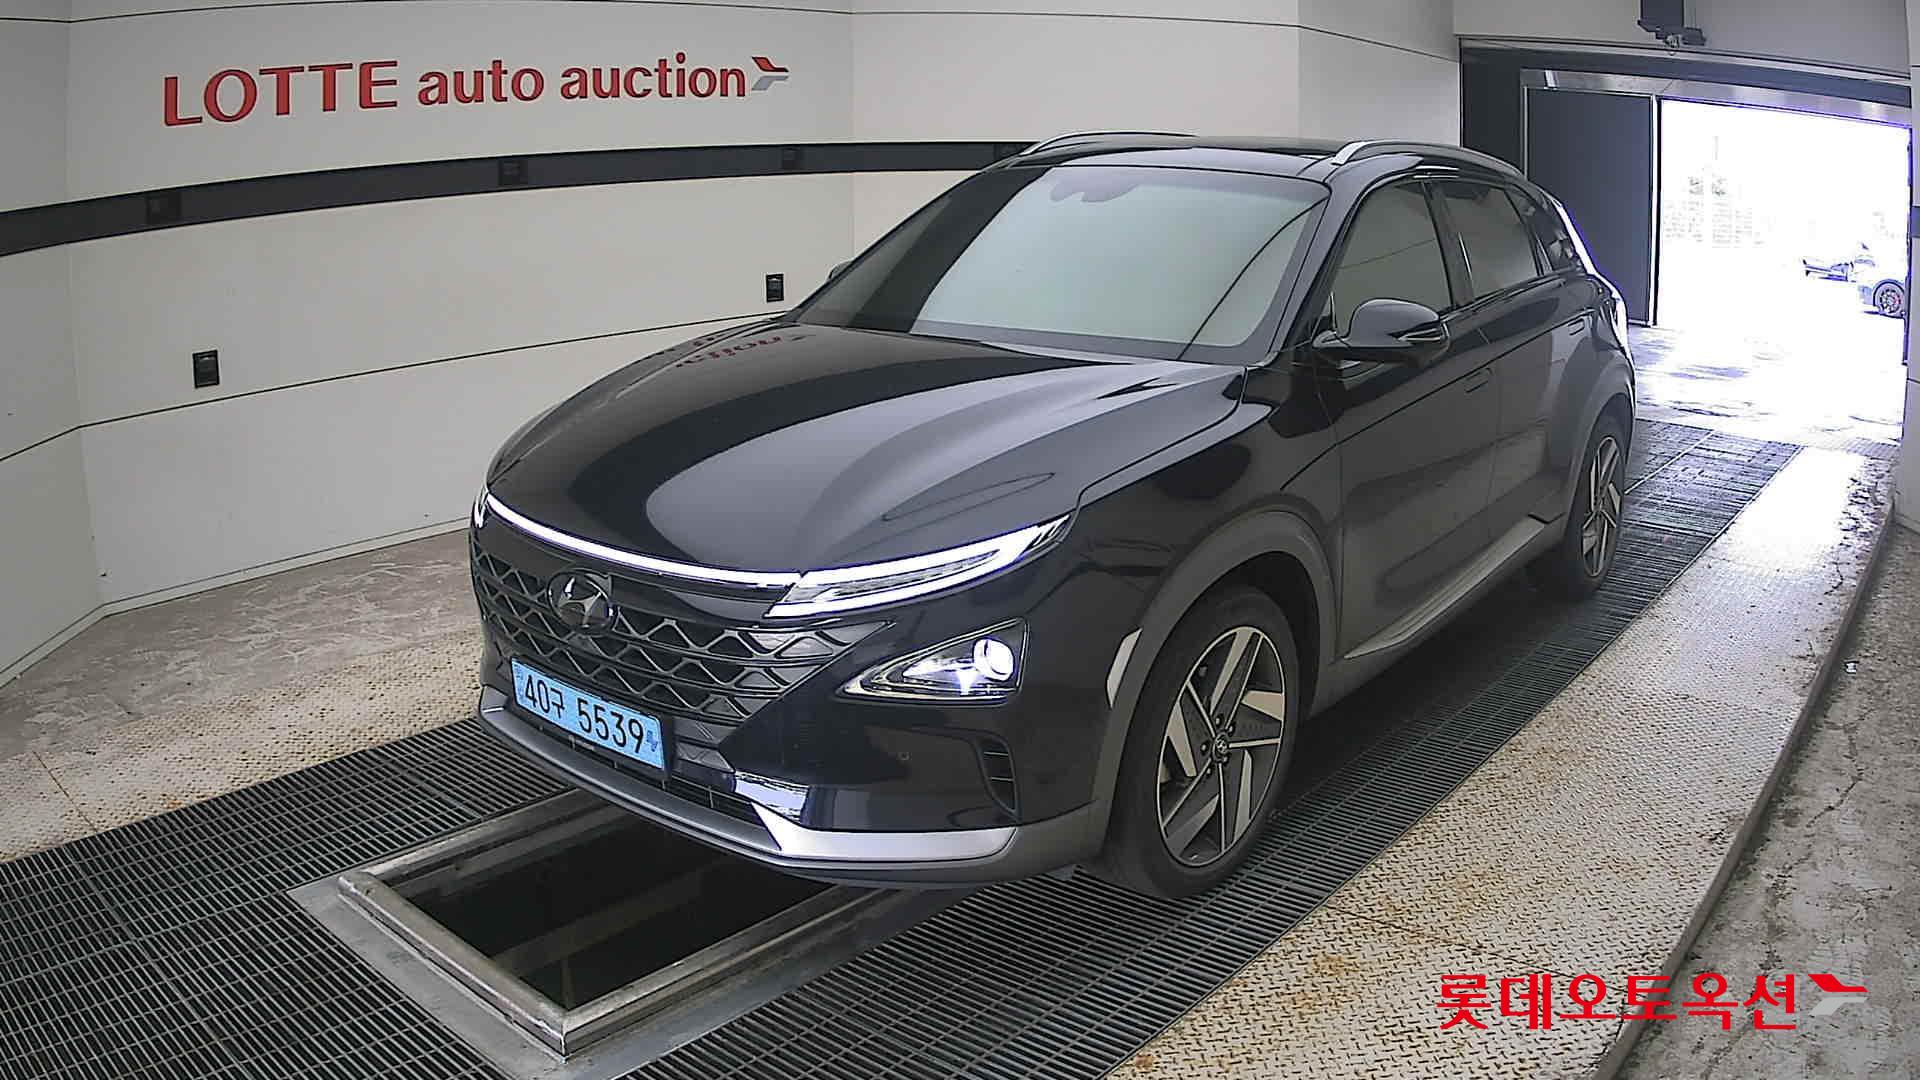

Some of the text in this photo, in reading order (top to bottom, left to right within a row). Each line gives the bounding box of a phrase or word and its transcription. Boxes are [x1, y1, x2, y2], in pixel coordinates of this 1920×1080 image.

[163, 52, 747, 126] LOTTE auto auction
[525, 674, 565, 719] 40구
[576, 697, 644, 753] 5539
